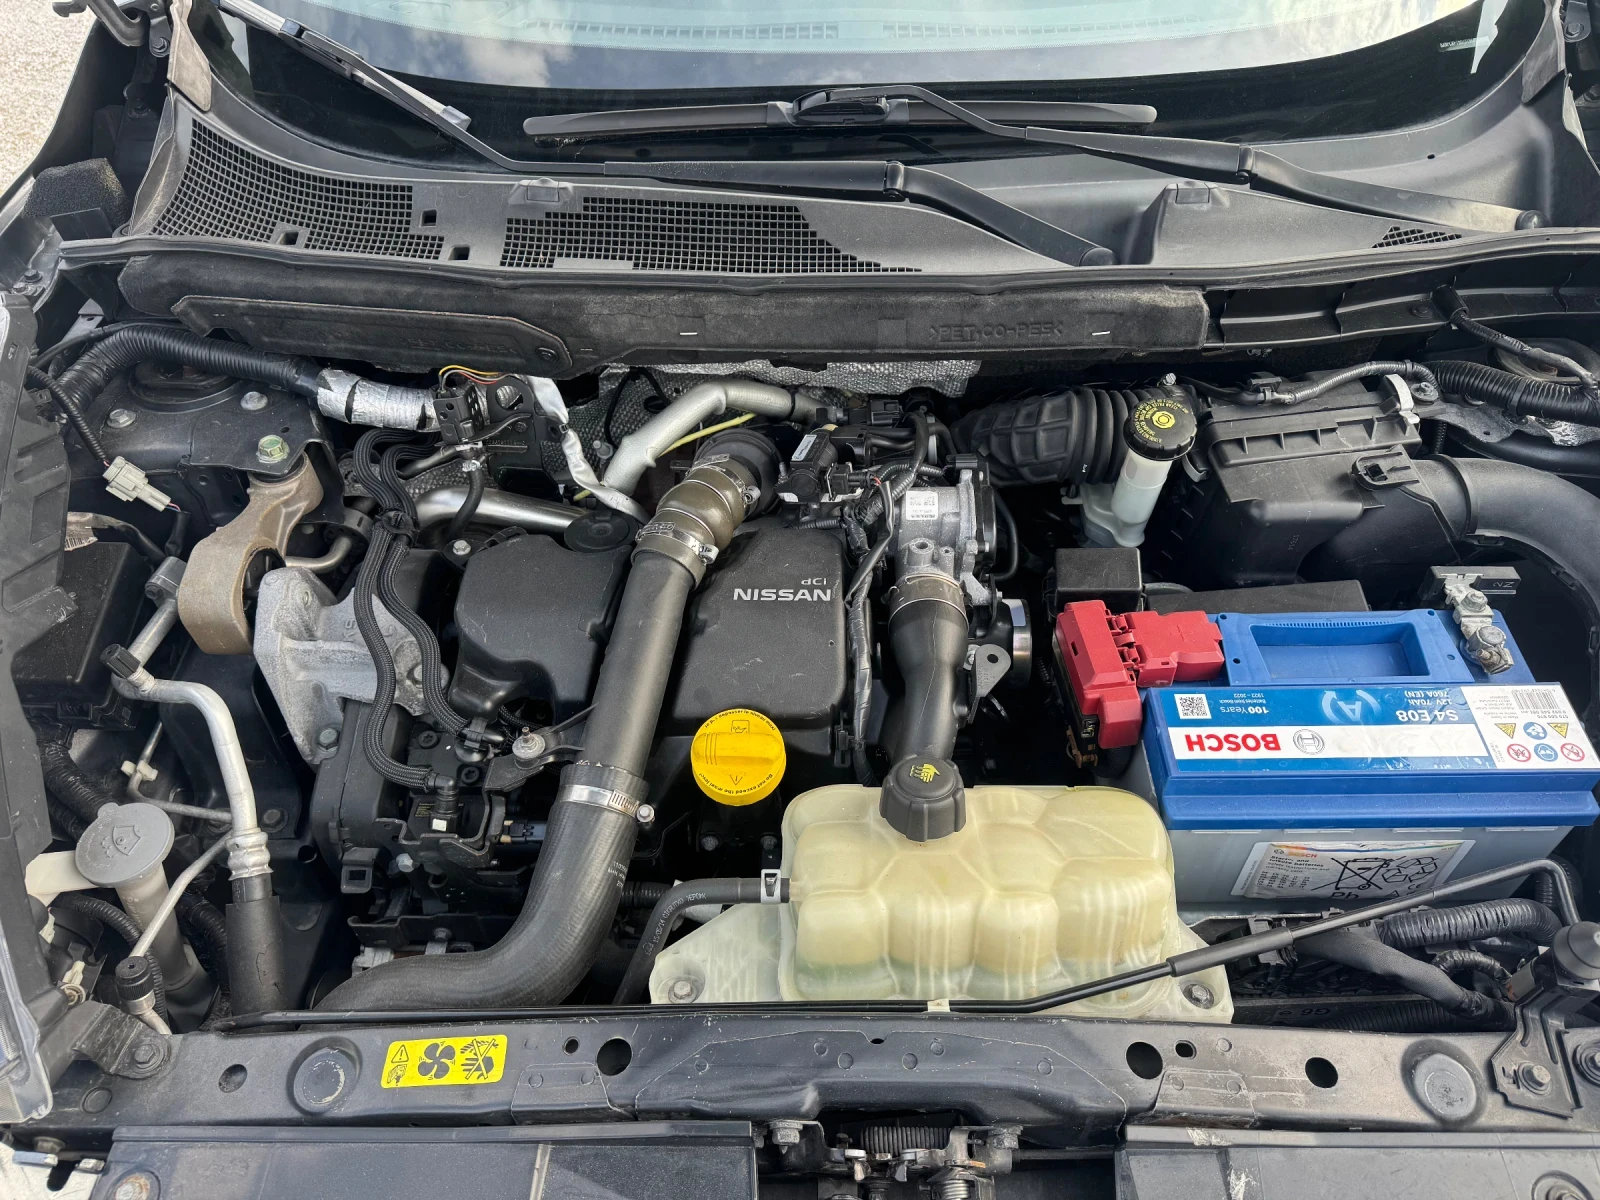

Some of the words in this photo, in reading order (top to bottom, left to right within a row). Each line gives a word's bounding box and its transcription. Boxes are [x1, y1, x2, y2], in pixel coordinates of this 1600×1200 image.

[801, 577, 827, 585] dCi
[733, 588, 832, 601] NISSAN
[1395, 709, 1431, 722] E08
[1433, 709, 1459, 721] S4
[1184, 733, 1282, 752] BOSCH
